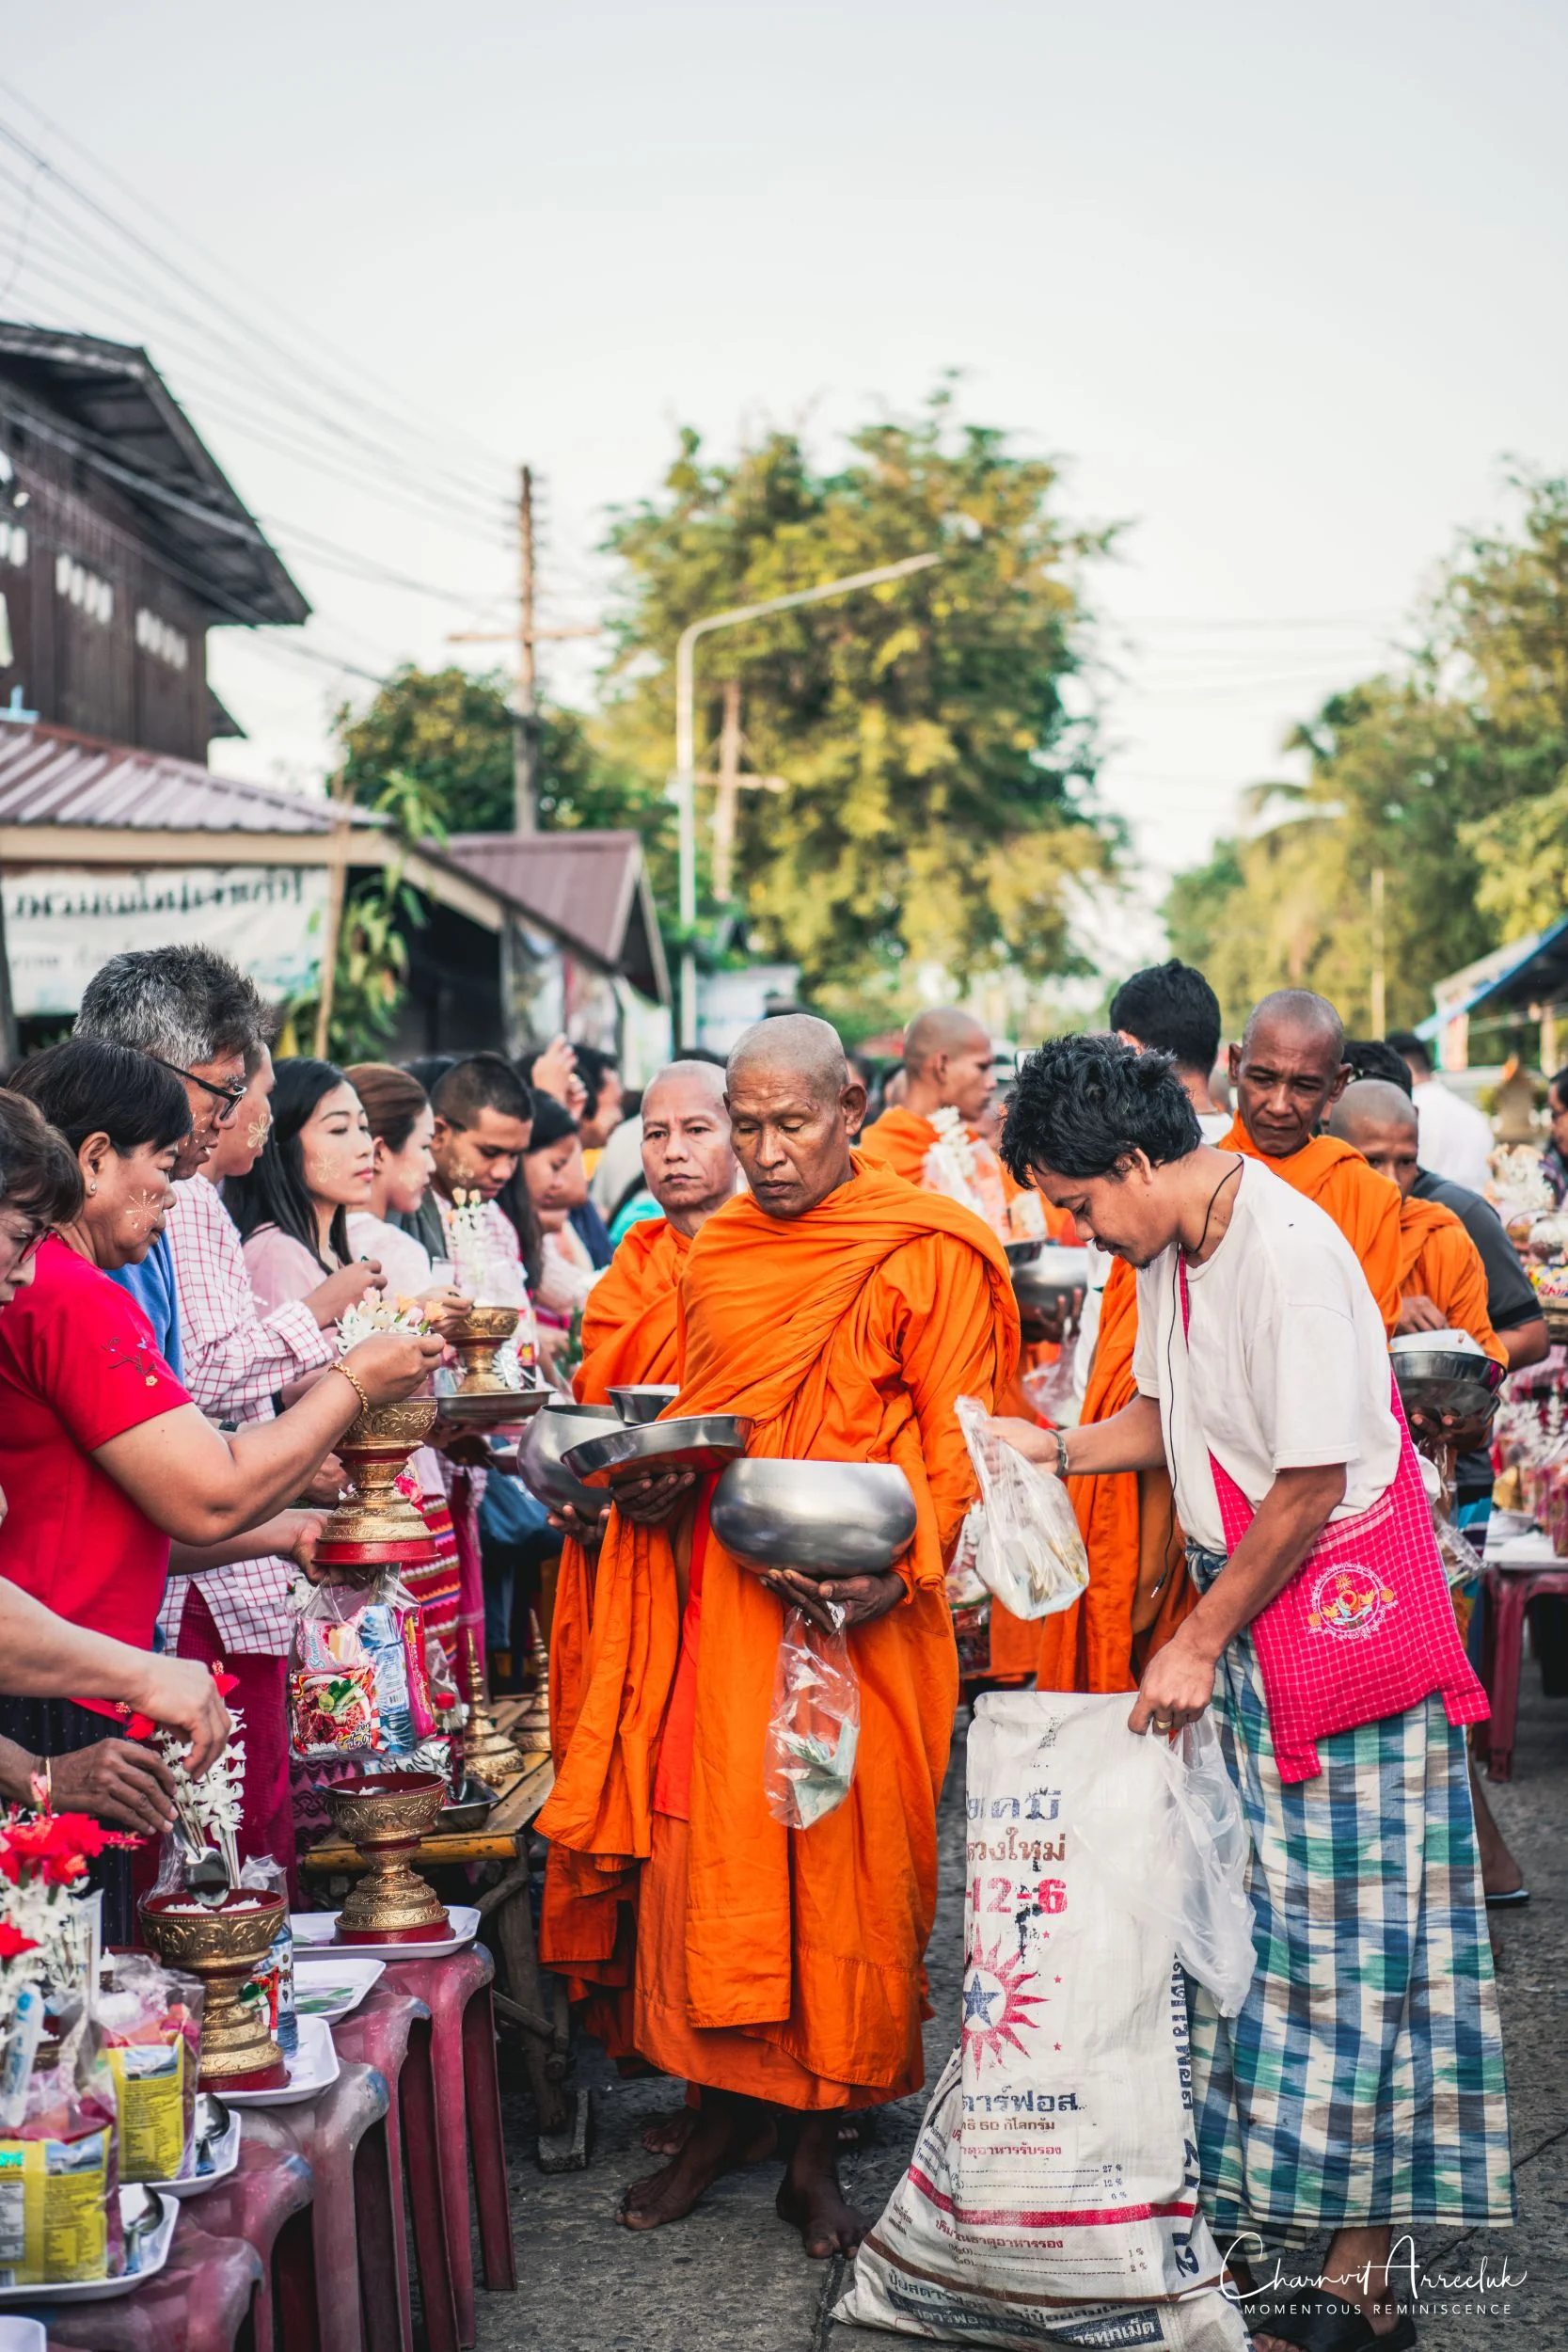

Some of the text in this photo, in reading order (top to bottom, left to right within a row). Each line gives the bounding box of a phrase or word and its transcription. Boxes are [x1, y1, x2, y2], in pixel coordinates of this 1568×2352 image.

[980, 2121, 1000, 2131] 50
[1102, 2165, 1113, 2173] 27
[1103, 2179, 1113, 2187] 12
